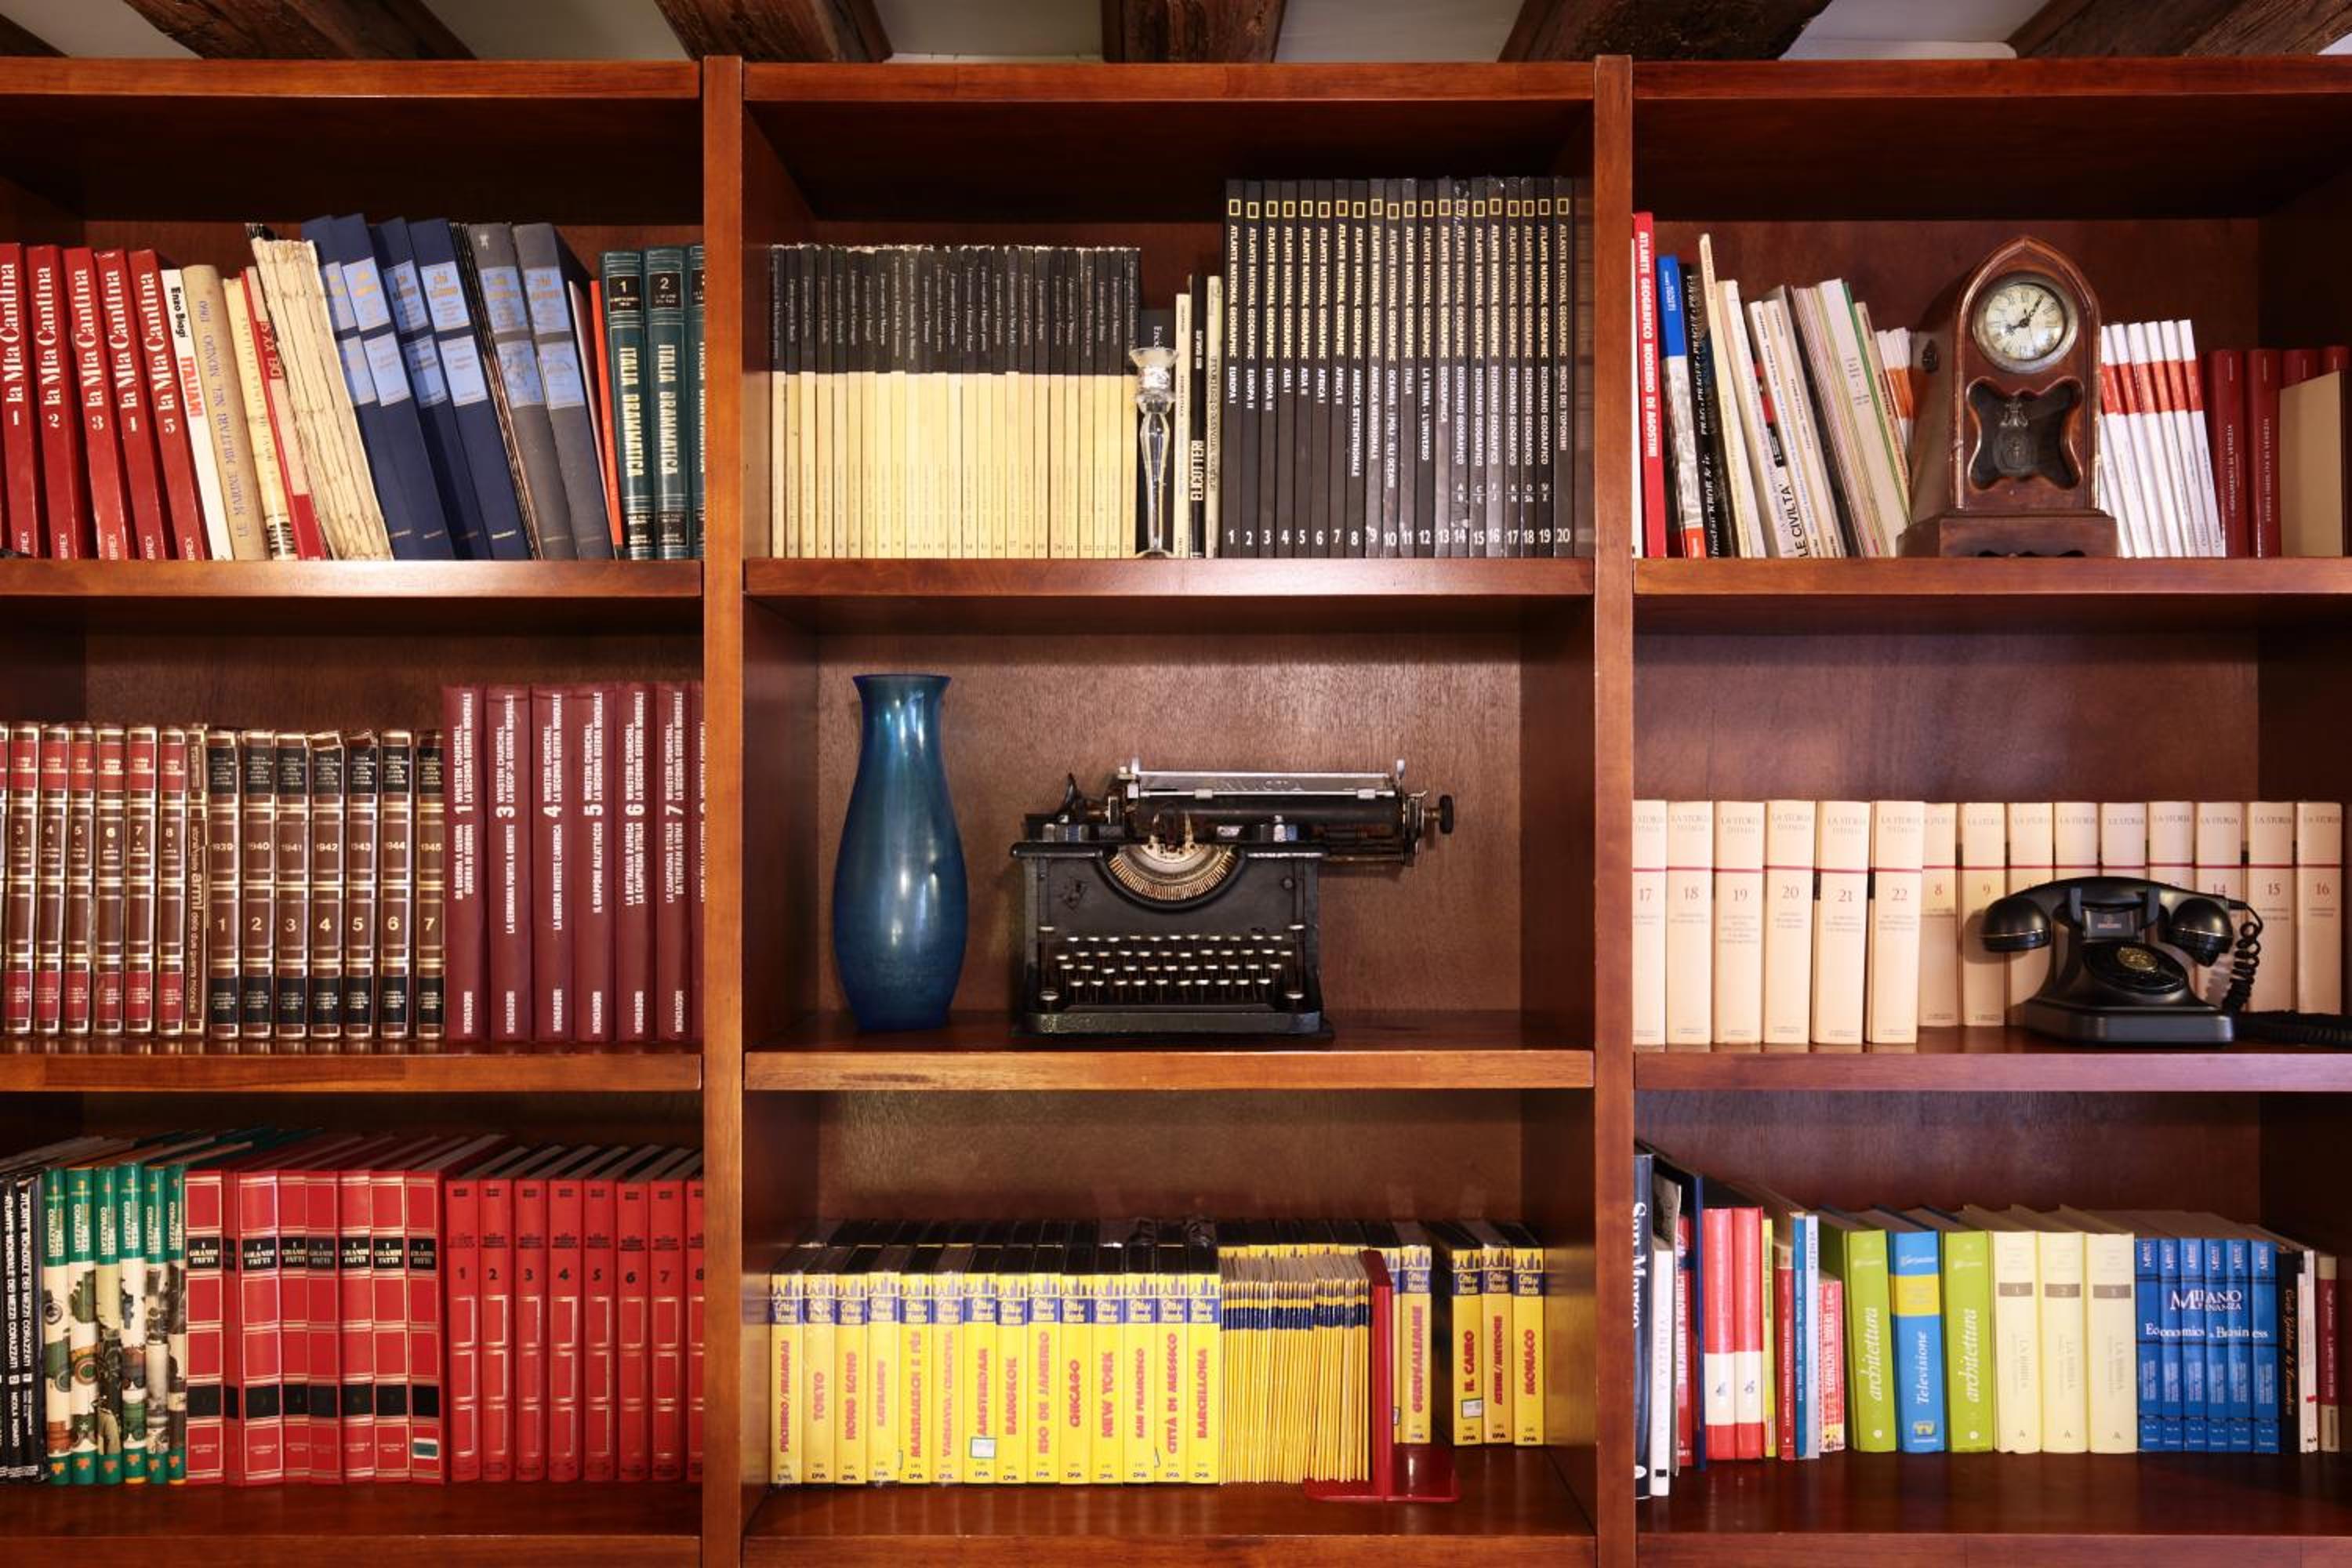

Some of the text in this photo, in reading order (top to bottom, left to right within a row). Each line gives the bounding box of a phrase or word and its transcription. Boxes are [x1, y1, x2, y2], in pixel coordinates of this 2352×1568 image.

[1248, 227, 1257, 264] ATLANTE
[620, 280, 628, 292] 1
[660, 277, 670, 290] 2
[1229, 263, 1238, 304] NATIONAL
[1247, 266, 1256, 307] NATIONAL
[170, 286, 189, 338] Enzo Biagi
[1229, 307, 1238, 358] GEOGRAPHIC
[1639, 231, 1658, 457] ATLANTE GEOGRAFICO MODERNO DE AGOSTINI
[263, 335, 283, 377] DEL XX
[180, 357, 204, 418] ITALIANI
[1265, 368, 1274, 400] EUROPA
[1335, 367, 1344, 396] AFRICA
[6, 386, 24, 402] la
[44, 389, 61, 405] la
[86, 390, 103, 407] la
[158, 394, 175, 411] la
[658, 344, 678, 475] ITALIA DRAMMATICA
[13, 410, 20, 426] 1
[619, 347, 644, 477] ITALIA DRAMMATICA
[48, 413, 60, 428] 2
[92, 415, 104, 430] 3
[164, 417, 176, 434] 5
[1190, 440, 1204, 502] ELICOTTERI
[1229, 530, 1235, 544] 1
[1264, 530, 1271, 544] 3
[1299, 530, 1305, 544] 5
[1334, 529, 1341, 543] 7
[1351, 531, 1359, 546] 8
[1384, 532, 1396, 546] 10
[1419, 530, 1431, 544] 12
[1454, 529, 1467, 543] 14
[1489, 528, 1501, 543] 16
[1523, 530, 1535, 544] 18
[1557, 528, 1570, 542] 20
[1795, 542, 1809, 557] LE
[454, 724, 463, 803] WINSTON CHURCHILL
[455, 805, 474, 815] 1
[495, 806, 515, 818] 3
[542, 806, 562, 818] 4
[584, 804, 603, 817] 5
[625, 804, 645, 817] 6
[665, 804, 684, 815] 7
[16, 826, 24, 835] 3
[45, 826, 53, 835] 4
[74, 826, 82, 836] 5
[107, 827, 115, 838] 6
[135, 826, 143, 835] 7
[165, 827, 173, 837] 8
[315, 842, 338, 852] 1942
[1639, 888, 1653, 902] 17
[1684, 887, 1700, 900] 18
[1733, 888, 1748, 902] 19
[1782, 885, 1799, 899] 20
[1838, 889, 1853, 902] 21
[1892, 888, 1907, 901] 22
[1935, 884, 1943, 896] 8
[2267, 883, 2281, 895] 15
[2316, 883, 2330, 895] 16
[217, 919, 226, 931] 1
[251, 917, 263, 931] 2
[285, 918, 296, 932] 3
[318, 918, 332, 931] 4
[352, 917, 364, 931] 5
[387, 917, 400, 931] 6
[424, 917, 435, 931] 7
[459, 1268, 466, 1280] 1
[488, 1269, 498, 1281] 2
[524, 1269, 533, 1281] 3
[558, 1268, 570, 1280] 4
[593, 1269, 601, 1281] 5
[626, 1272, 636, 1284] 6
[660, 1270, 670, 1283] 7
[695, 1269, 704, 1280] 8
[2170, 1288, 2243, 1311] MILANO
[9, 1321, 19, 1369] CORAZZATI
[1411, 1305, 1424, 1414] GERUSALEMME
[1463, 1330, 1475, 1392] IL CAIRO
[1859, 1306, 1883, 1403] architettura
[1958, 1308, 1981, 1403] architettura
[1167, 1332, 1178, 1393] MESSICO
[1523, 1329, 1536, 1396] MONACO
[1916, 1330, 1931, 1406] Televisione
[814, 1371, 824, 1421] TOKYO
[977, 1348, 988, 1436] AMSTERDAM
[1005, 1357, 1017, 1436] BANGKOK
[1069, 1359, 1080, 1428] CHICAGO
[1101, 1351, 1114, 1439] NEW YORK
[1134, 1348, 1145, 1439] SAN FRANCISCO
[1196, 1348, 1208, 1439] BARCELLONA
[1167, 1396, 1178, 1412] DI
[1038, 1402, 1049, 1421] DE
[1037, 1426, 1049, 1454] RIO
